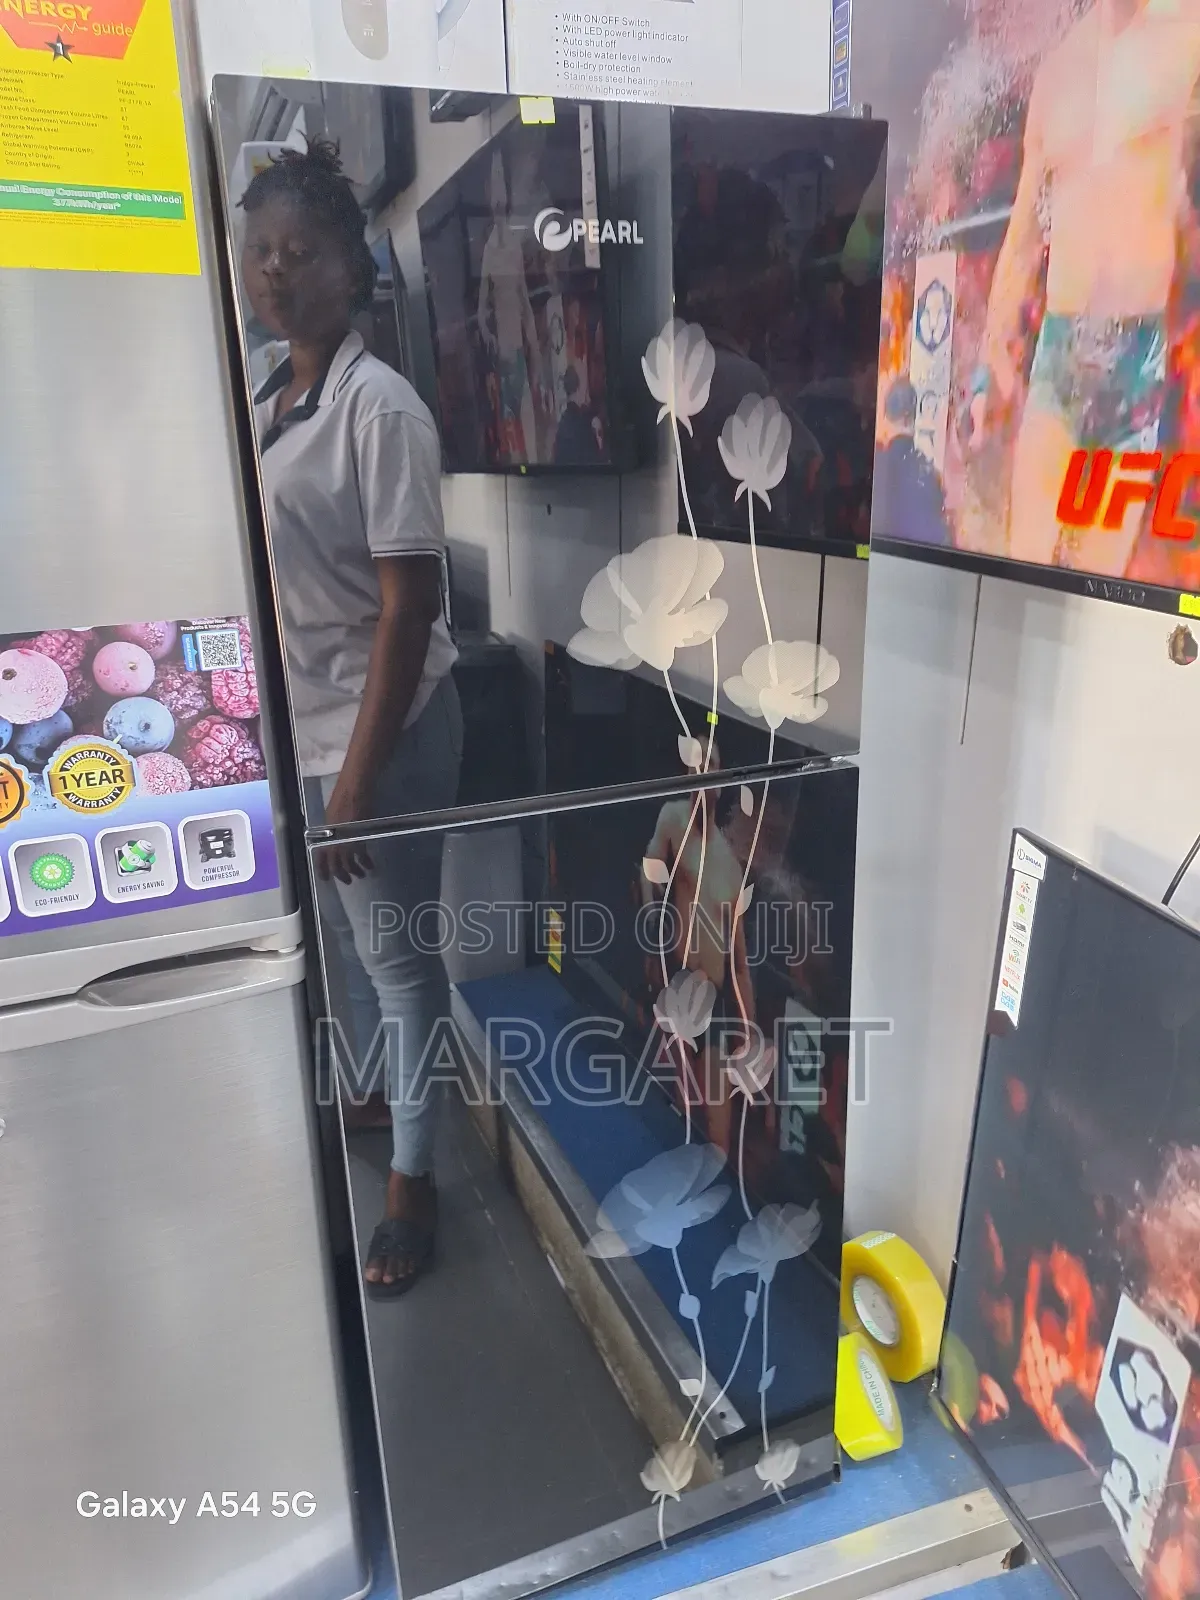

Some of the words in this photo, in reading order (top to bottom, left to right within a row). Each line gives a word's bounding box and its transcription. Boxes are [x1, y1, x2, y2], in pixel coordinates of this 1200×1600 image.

[0, 0, 92, 20] NERGY
[562, 13, 582, 23] With
[584, 14, 620, 25] ON/OFF
[622, 17, 650, 28] Switch
[92, 22, 134, 36] guide
[562, 25, 582, 34] With
[584, 27, 603, 36] LED
[604, 29, 631, 39] power
[632, 29, 651, 41] light
[652, 31, 689, 42] indicator
[563, 36, 583, 46] Auto
[584, 38, 603, 48] shut
[605, 39, 617, 49] off
[563, 48, 592, 58] Visible
[594, 51, 618, 60] water
[619, 52, 640, 62] level
[642, 54, 673, 64] window
[563, 60, 597, 71] Boil-dry
[599, 61, 641, 73] protection
[563, 72, 603, 82] Stainless
[605, 74, 626, 84] steel
[627, 75, 659, 87] heating
[595, 84, 614, 96] high
[615, 87, 642, 97] power
[56, 188, 121, 200] Consumption
[154, 195, 183, 204] Model
[572, 218, 644, 244] PEARL
[1056, 449, 1200, 539] UFC
[64, 750, 117, 770] WARRANTY
[58, 775, 68, 790] 1
[70, 768, 126, 788] YEAR
[68, 787, 122, 808] WARRANTY
[201, 870, 240, 882] COMPRESSOR
[203, 864, 235, 874] POWERFUL
[117, 883, 142, 894] ENERGY
[142, 880, 165, 890] SAVING
[34, 893, 80, 907] ECO-FRIENDLY
[867, 1379, 876, 1390] IN
[872, 1388, 886, 1417] MADE
